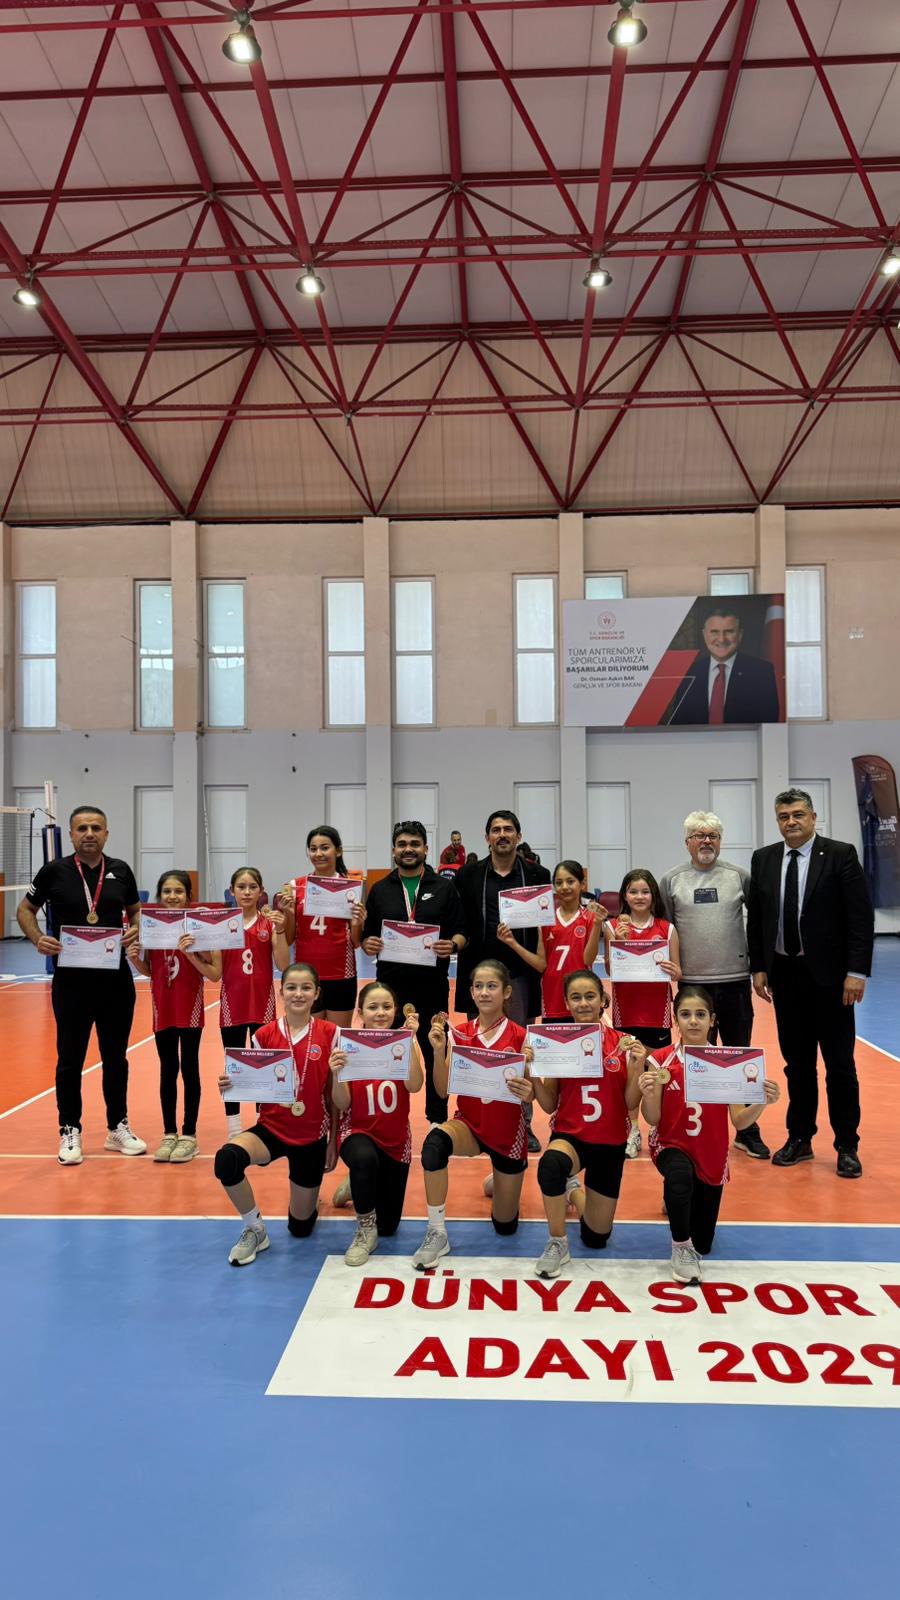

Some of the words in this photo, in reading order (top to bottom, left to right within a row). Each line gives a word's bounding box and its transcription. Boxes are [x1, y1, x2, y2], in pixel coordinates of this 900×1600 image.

[568, 648, 587, 656] TÜM
[588, 646, 635, 656] ANTRENÖR
[636, 647, 647, 655] VE
[570, 655, 645, 665] SPORCULARIMIZA
[566, 666, 607, 674] BAŞARILAR
[310, 916, 327, 936] 4
[168, 955, 180, 980] 9
[242, 949, 253, 975] 8
[555, 945, 570, 971] 7
[366, 1080, 398, 1116] 10
[581, 1085, 602, 1122] 5
[685, 1103, 703, 1137] 3
[354, 1270, 632, 1313] DÜNYA
[651, 1281, 877, 1317] SPOR
[393, 1336, 675, 1382] ADAYI
[698, 1340, 900, 1386] 2029
